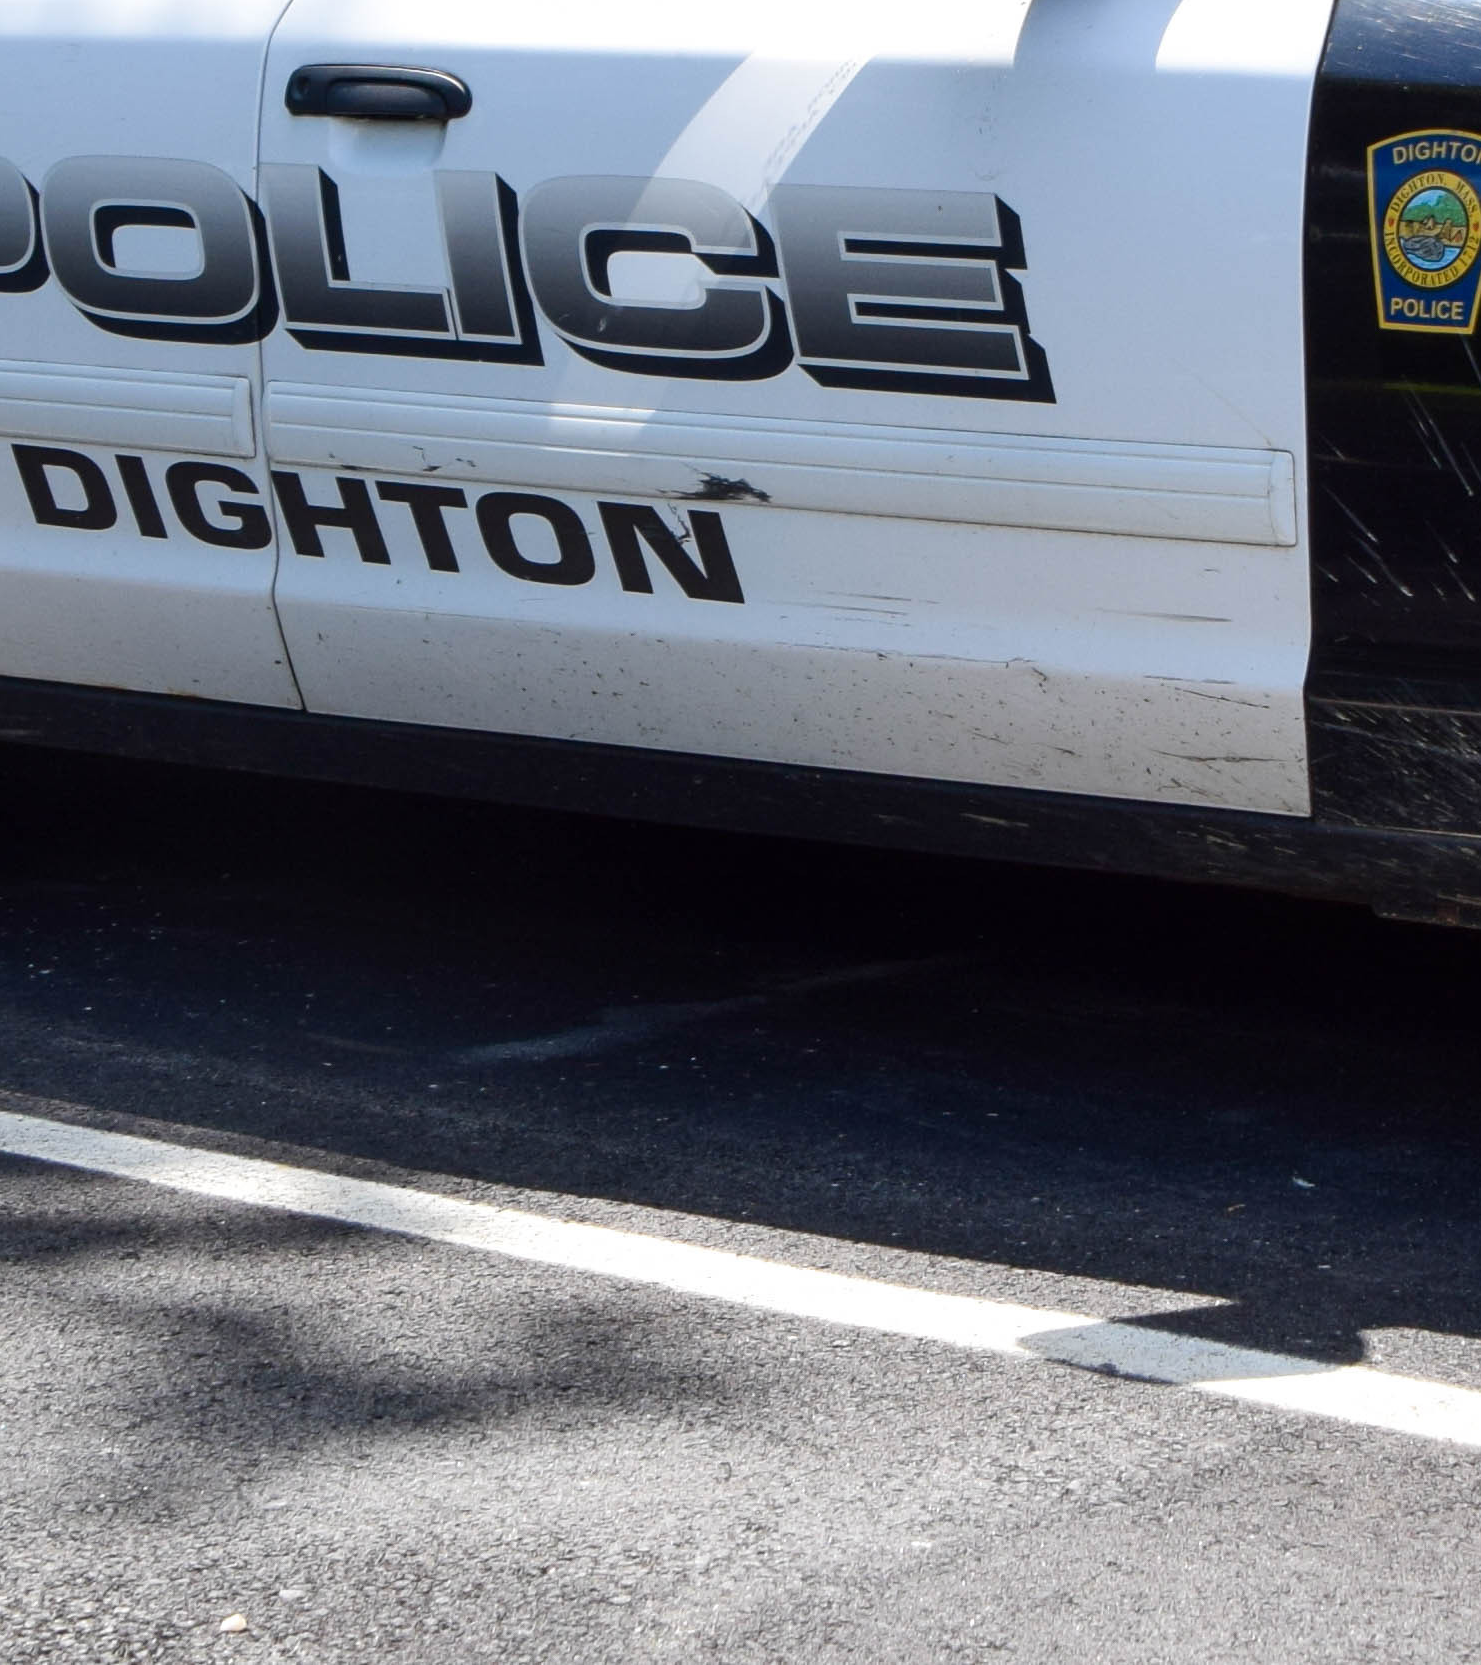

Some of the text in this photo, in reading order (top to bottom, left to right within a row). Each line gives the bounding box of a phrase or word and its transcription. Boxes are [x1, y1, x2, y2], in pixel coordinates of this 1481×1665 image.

[1385, 232, 1459, 286] INCORPORATED
[1390, 297, 1464, 321] POLICE
[9, 443, 745, 604] DIGHTON
